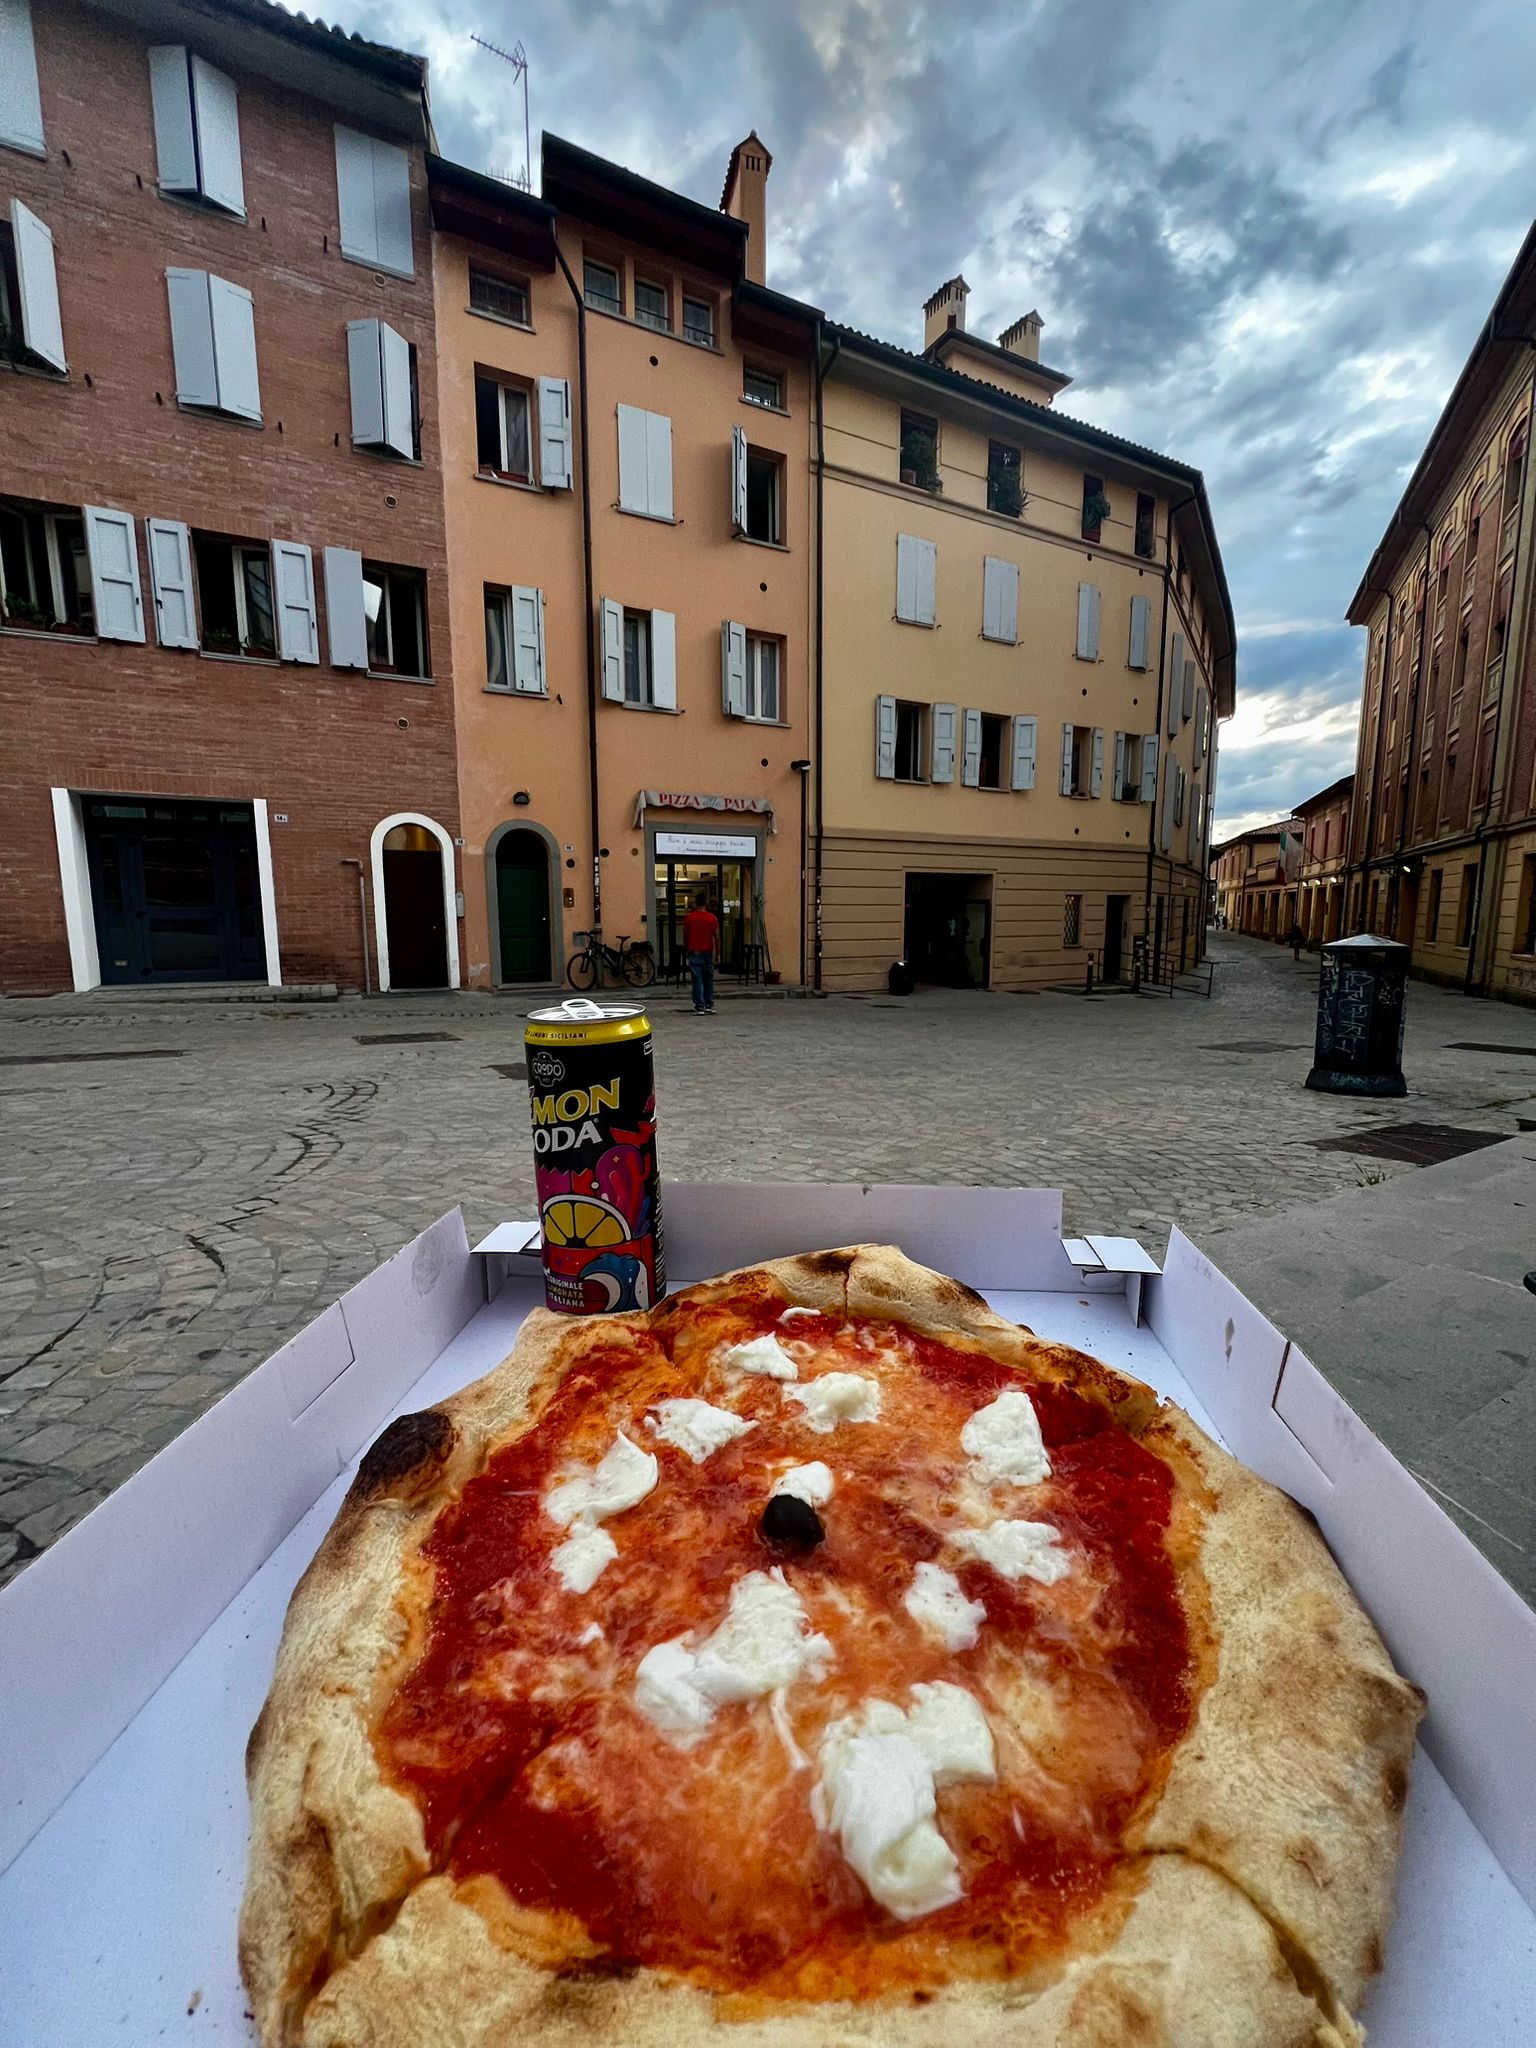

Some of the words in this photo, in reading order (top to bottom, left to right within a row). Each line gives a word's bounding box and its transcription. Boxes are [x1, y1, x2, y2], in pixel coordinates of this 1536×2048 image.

[659, 793, 700, 806] PIZZA
[724, 798, 758, 809] PALA
[529, 1077, 621, 1126] MON
[533, 1120, 603, 1153] ODA
[549, 1291, 585, 1307] ITALIANA
